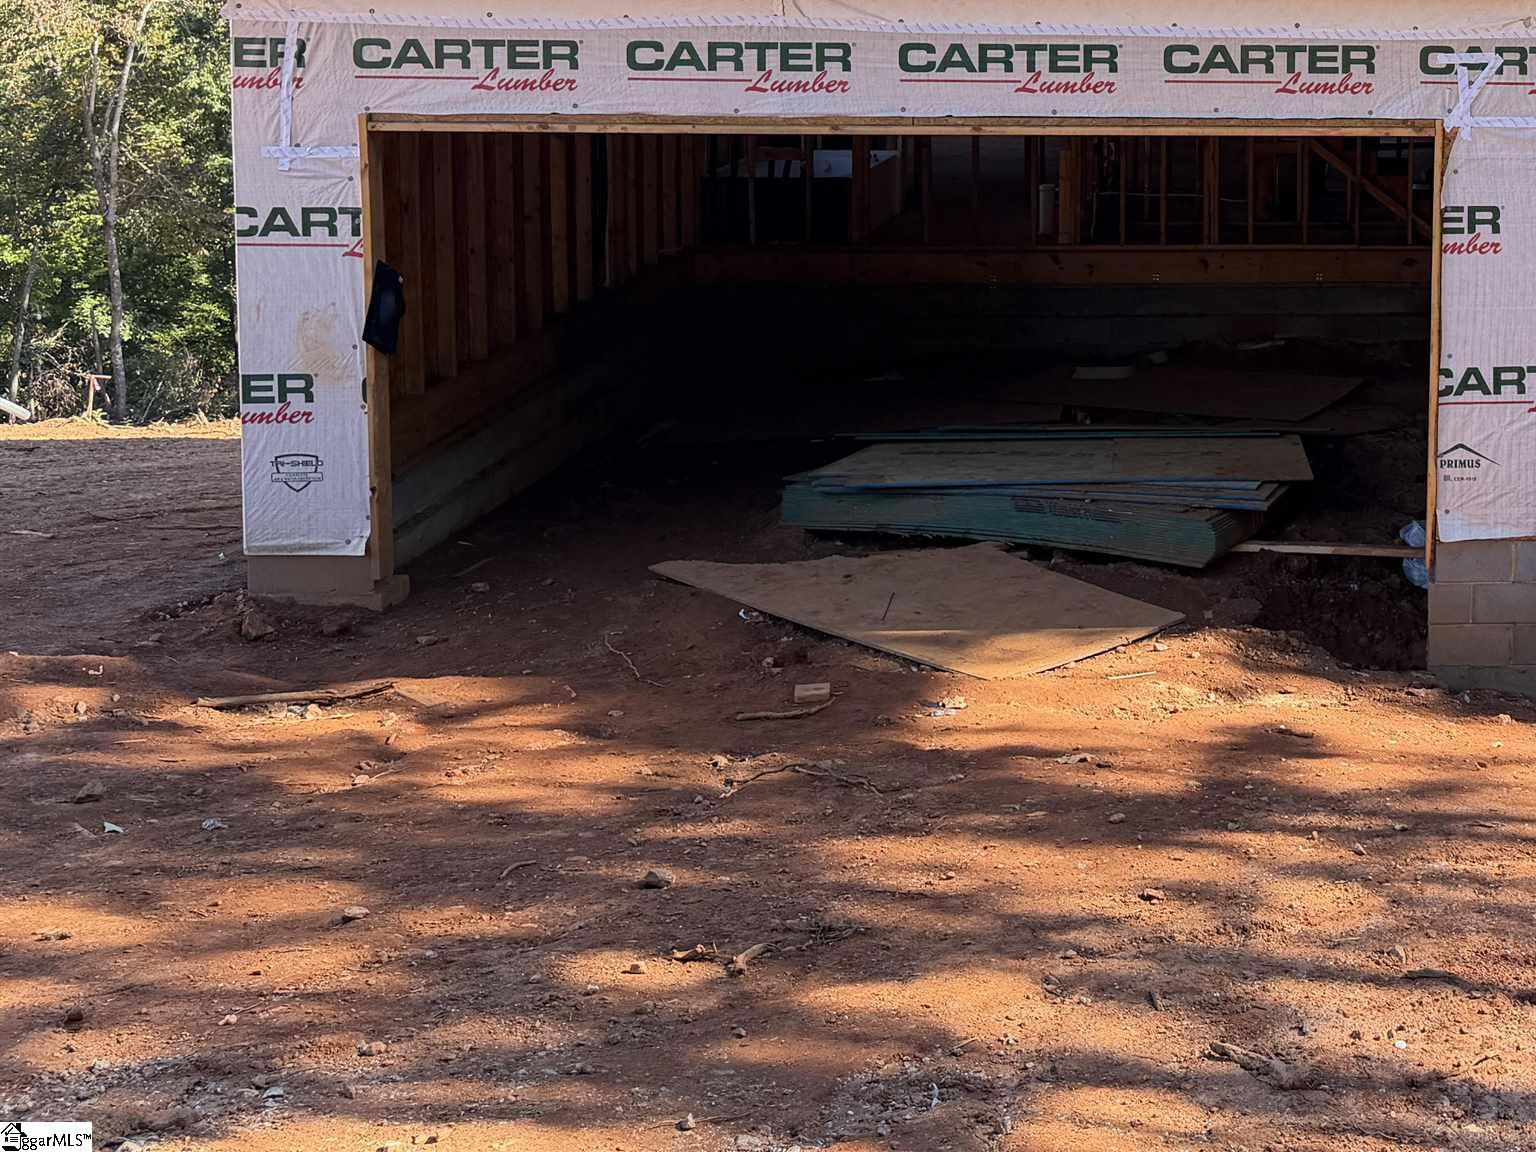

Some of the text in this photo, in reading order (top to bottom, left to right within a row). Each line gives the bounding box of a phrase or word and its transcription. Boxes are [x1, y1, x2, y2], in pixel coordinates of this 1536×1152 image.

[352, 38, 579, 71] CARTER
[625, 40, 853, 73] CARTER
[899, 42, 1119, 74] CARTER
[1163, 44, 1376, 75] CARTER
[473, 68, 579, 92] Lumber
[743, 69, 850, 94] Lumber
[1014, 71, 1116, 96] Lumber
[1275, 73, 1374, 96] Lumber
[241, 373, 315, 404] ER
[1439, 458, 1481, 469] PRIMUS
